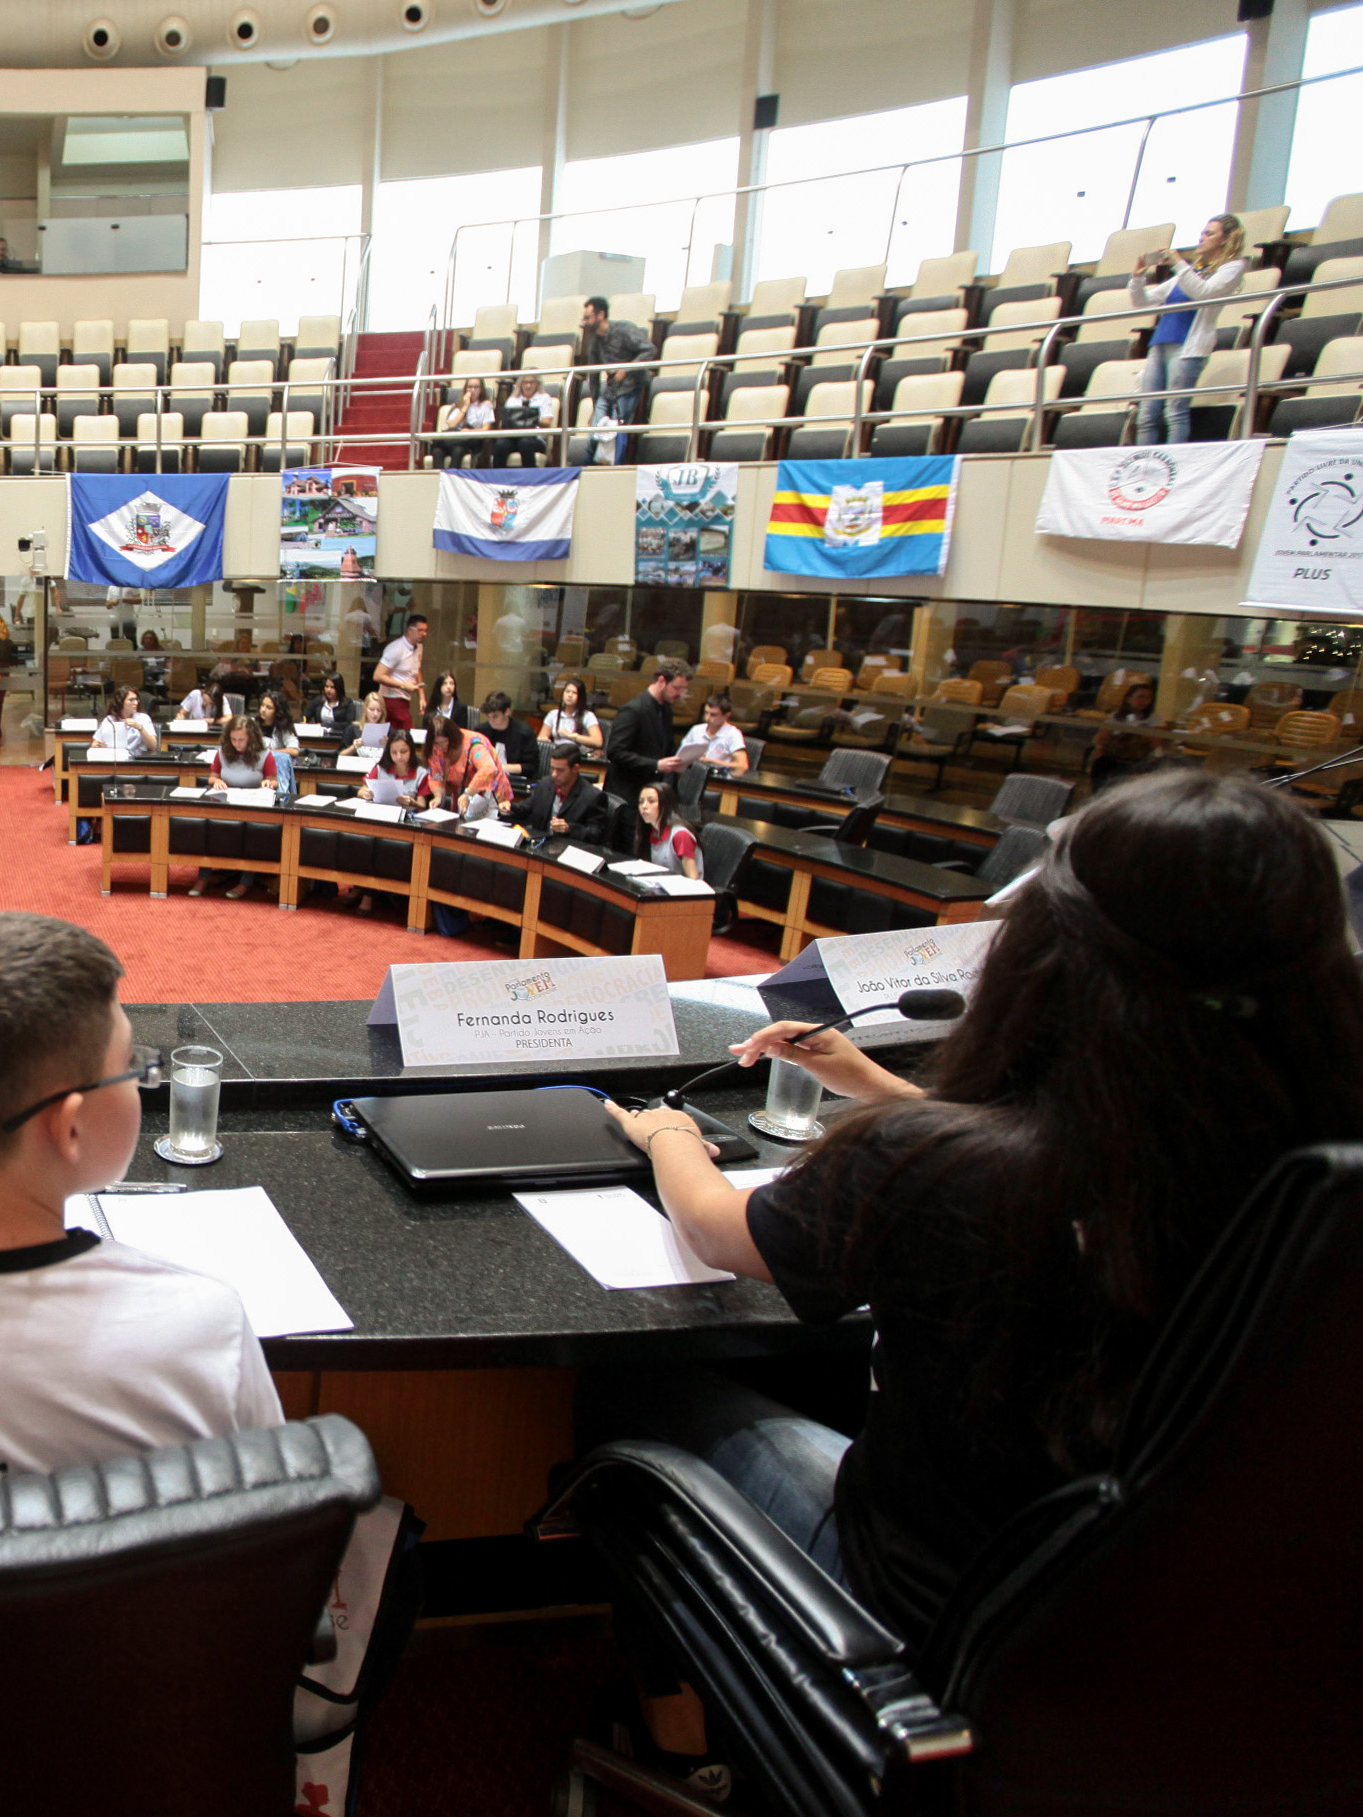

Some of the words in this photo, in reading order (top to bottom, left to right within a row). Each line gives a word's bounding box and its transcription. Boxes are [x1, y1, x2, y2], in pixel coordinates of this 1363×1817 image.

[1292, 568, 1332, 580] PLUS
[505, 971, 551, 993] Parlamento
[510, 977, 556, 1002] JOVEM
[857, 980, 885, 994] João
[884, 977, 912, 990] Vitor
[914, 974, 931, 986] da
[930, 970, 958, 984] Silva
[457, 1011, 532, 1028] Fernanda
[538, 1009, 615, 1026] Rodrigues
[499, 1028, 531, 1038] Partido
[534, 1027, 563, 1037] Jovens
[579, 1026, 602, 1038] Ação
[516, 1038, 573, 1049] PRESIDENTA
